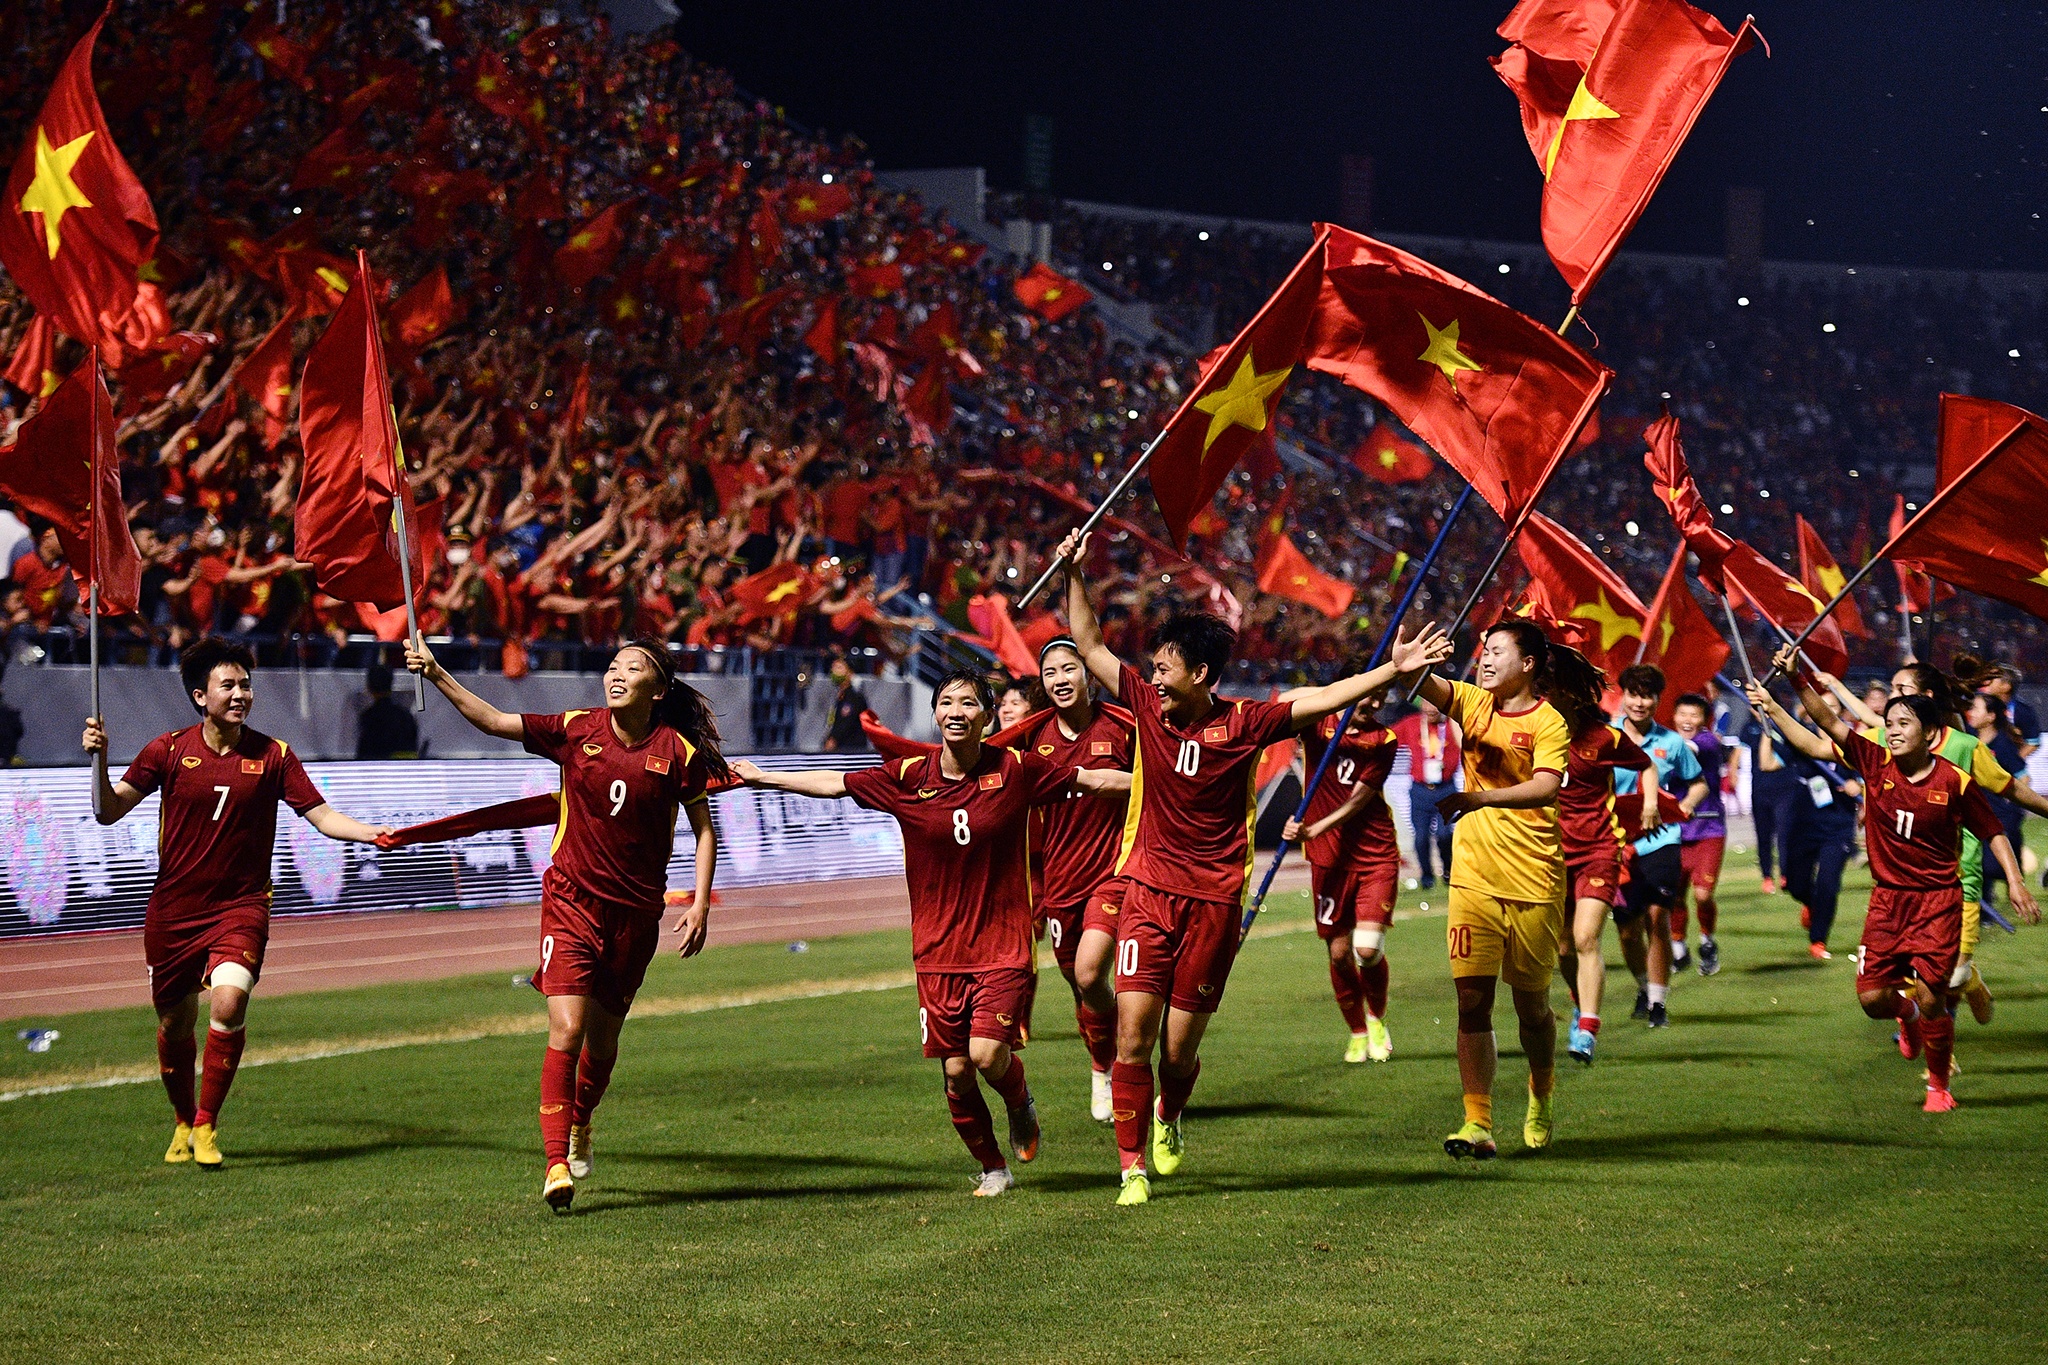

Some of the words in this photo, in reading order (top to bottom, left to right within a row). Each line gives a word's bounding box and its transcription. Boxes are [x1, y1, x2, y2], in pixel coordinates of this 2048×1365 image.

[1174, 738, 1200, 777] 10
[212, 785, 230, 821] 7
[609, 779, 627, 816] 9
[952, 808, 971, 846] 8
[1895, 808, 1914, 840] 11
[1316, 894, 1335, 926] 12
[542, 935, 554, 973] 9
[1116, 938, 1139, 976] 10
[1449, 925, 1472, 960] 20
[919, 1006, 928, 1045] 8
